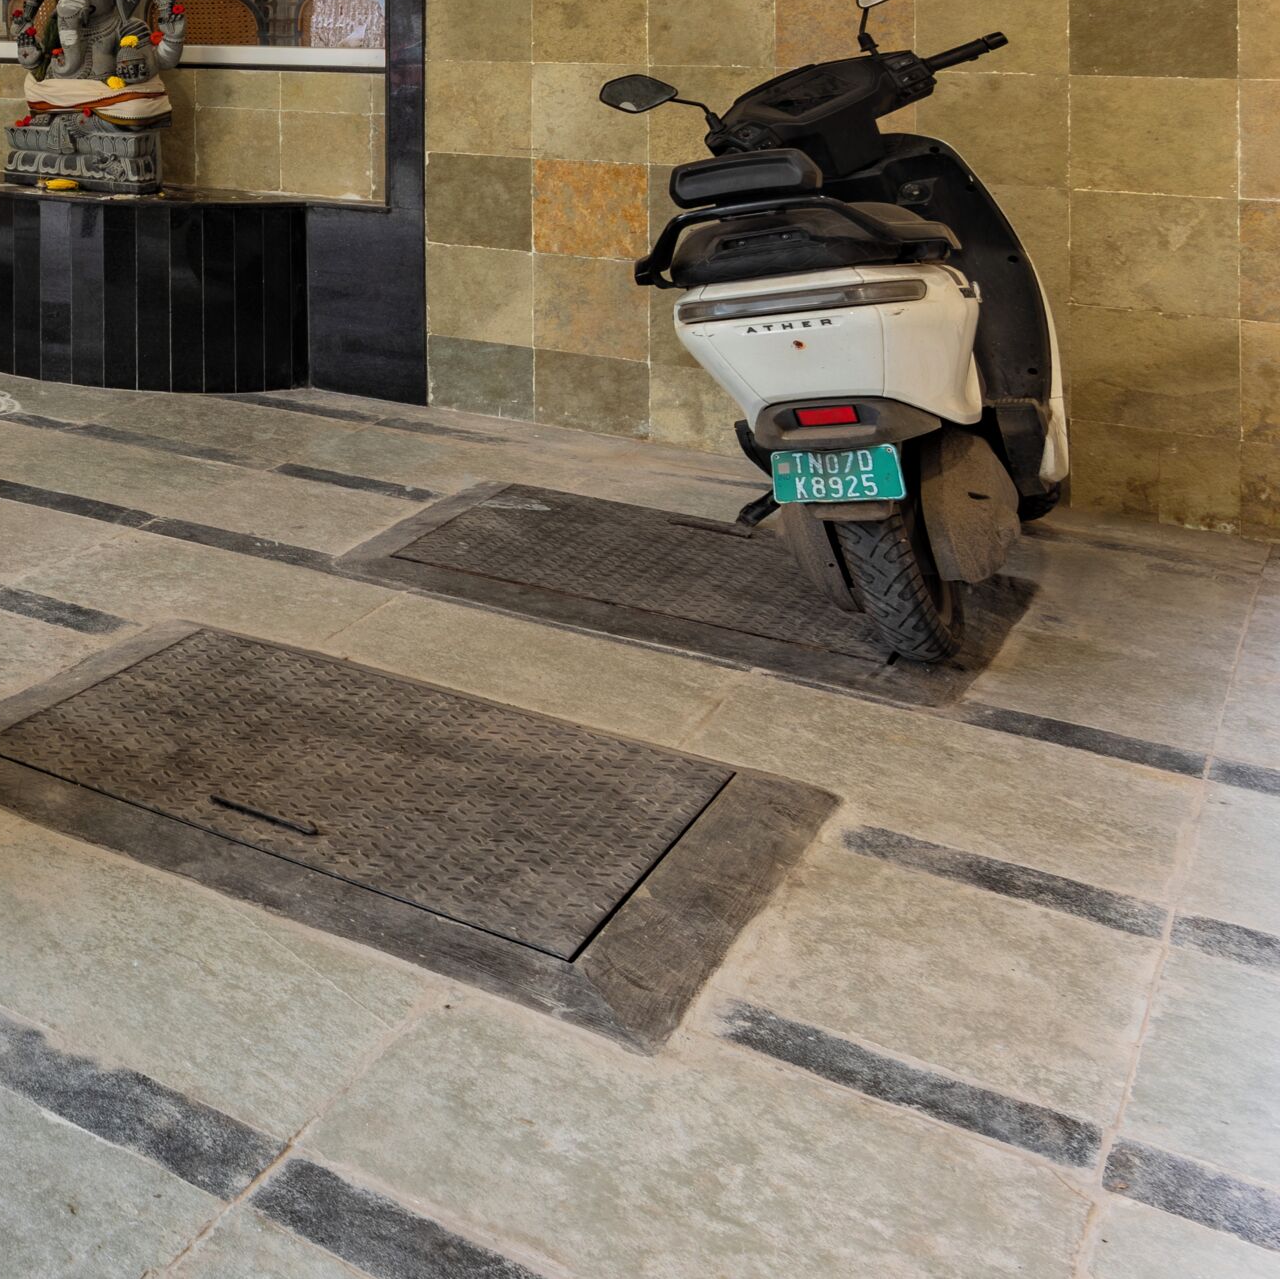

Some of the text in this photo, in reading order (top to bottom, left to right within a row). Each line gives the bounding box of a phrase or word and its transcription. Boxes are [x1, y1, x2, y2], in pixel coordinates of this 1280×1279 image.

[746, 319, 832, 334] ATHER
[792, 450, 873, 475] TN07D
[795, 474, 878, 499] K8925
